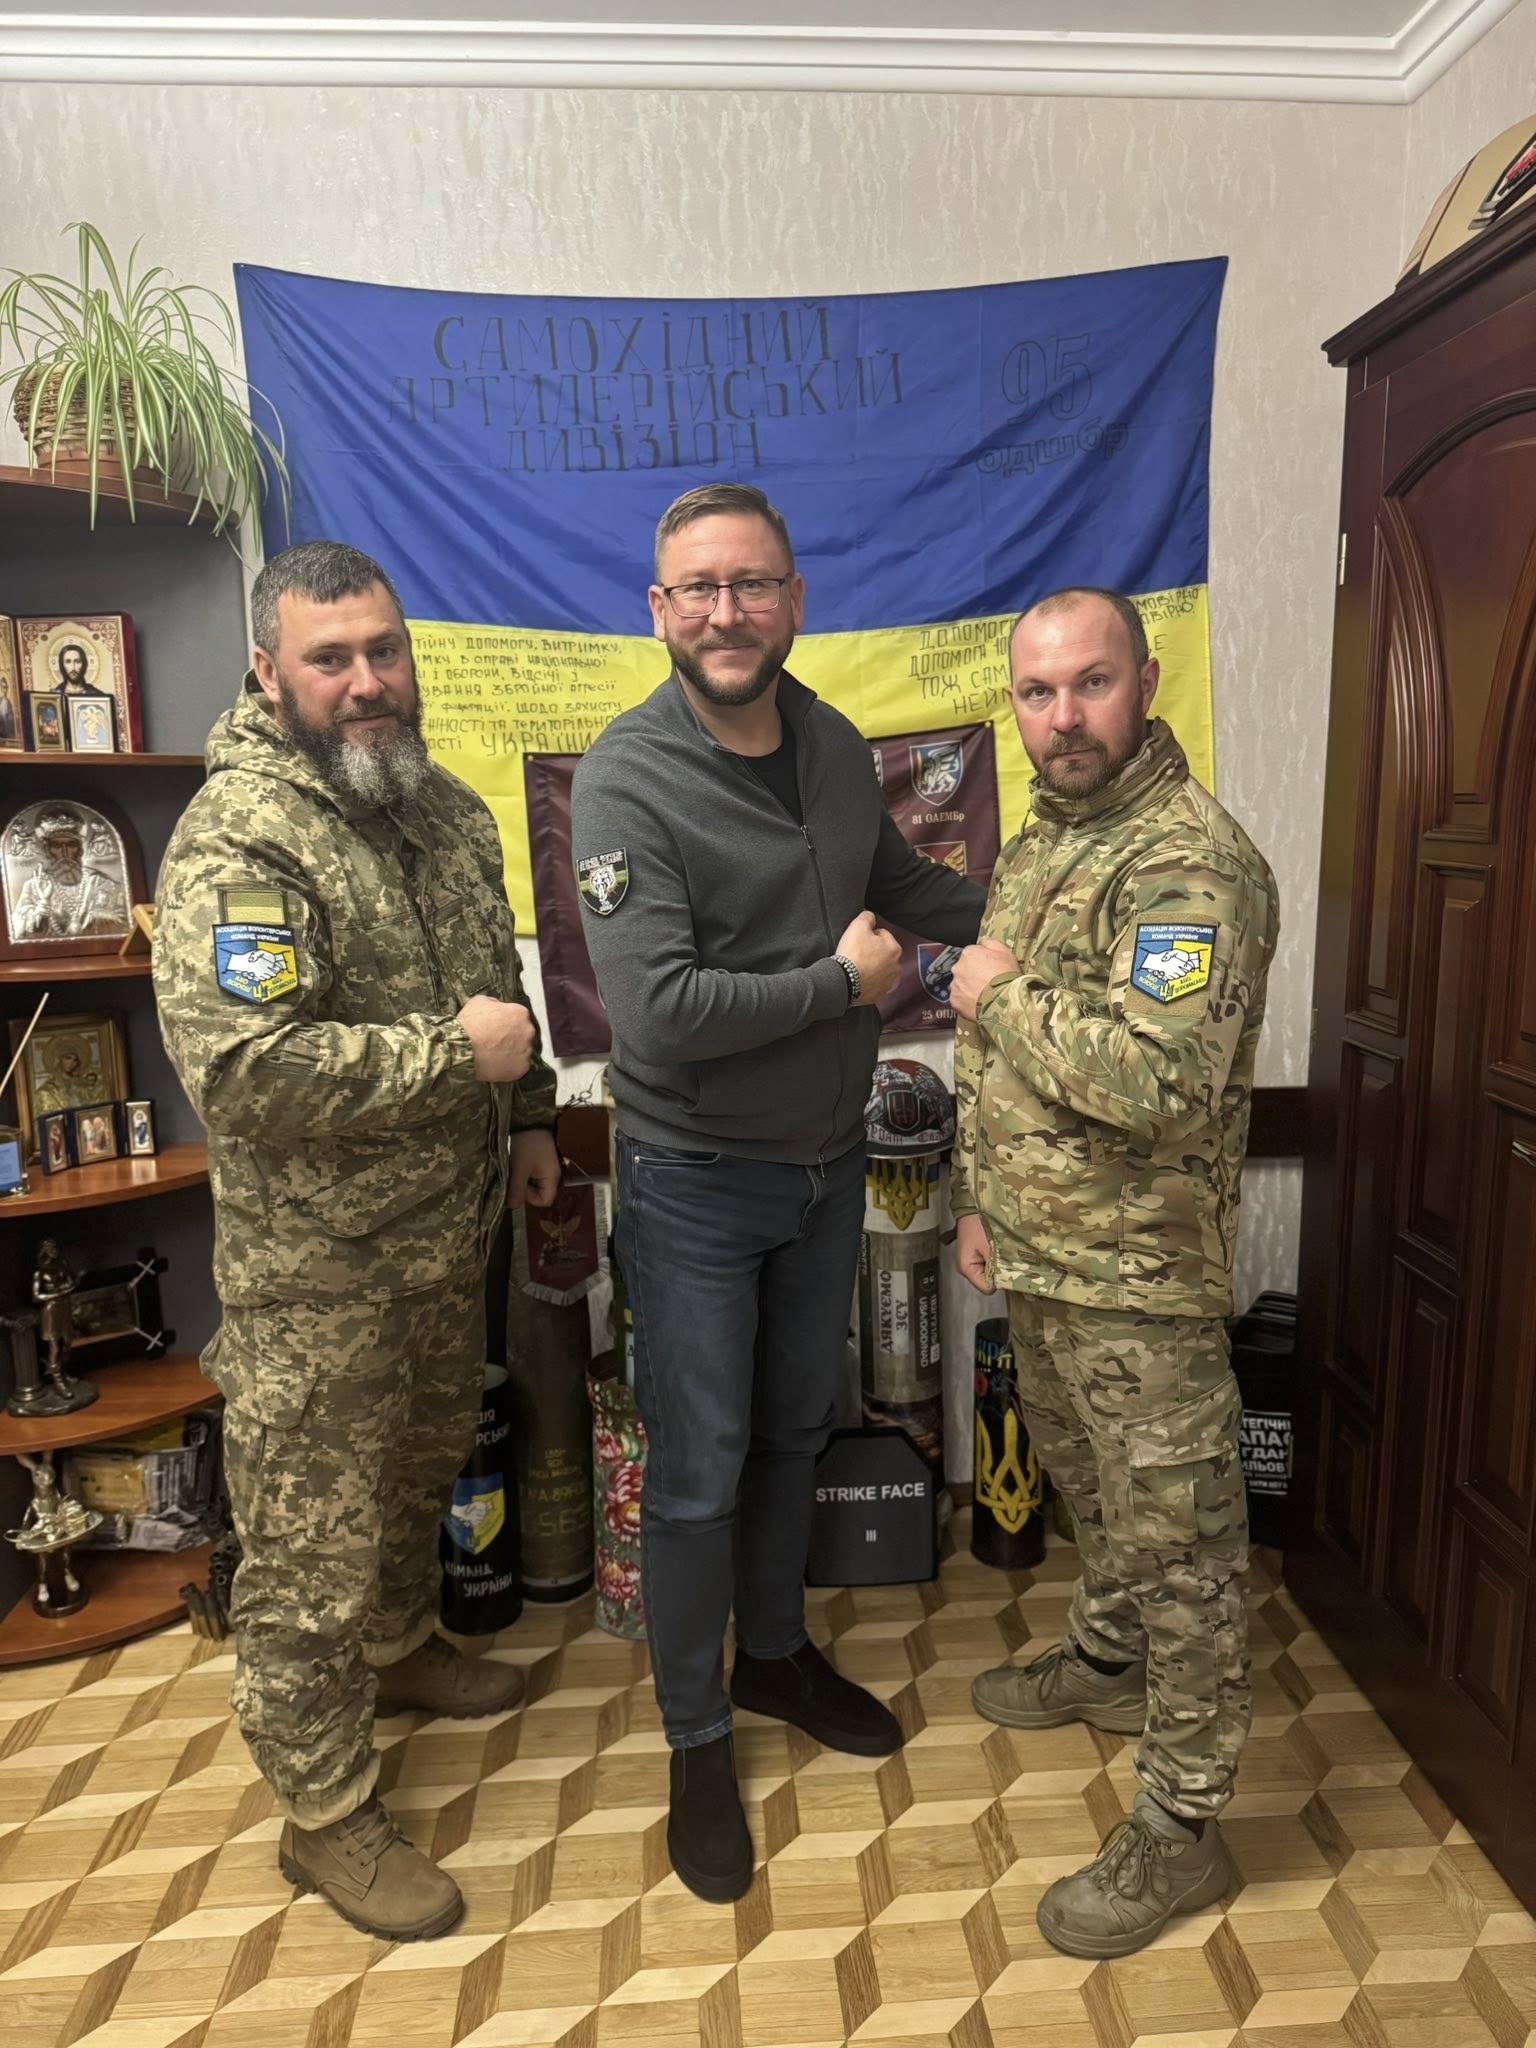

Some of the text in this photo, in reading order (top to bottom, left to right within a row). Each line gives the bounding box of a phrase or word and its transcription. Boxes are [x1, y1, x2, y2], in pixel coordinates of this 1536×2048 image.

[432, 303, 832, 374] САМОХІДНИЙ
[386, 347, 904, 427] АРТИЛЕРІЙСЬКИЙ
[1002, 333, 1093, 428] 95
[506, 420, 764, 473] ДИВІЗІОН
[1135, 588, 1199, 612] МОВІРНО
[415, 634, 456, 649] ТІЙНУ
[908, 643, 986, 678] ДОПОМОГА
[1140, 601, 1195, 625] ОВІРНО.
[422, 683, 482, 697] УВАННЯ
[917, 673, 962, 700] ТОЖ
[488, 719, 506, 731] ТА
[427, 731, 593, 757] ОСТІ УКРАЇНИ
[911, 814, 922, 825] 81
[921, 1010, 933, 1020] 25
[880, 1270, 892, 1353] ДЯКУЄМО
[896, 1301, 908, 1331] ЗСУ
[1239, 1430, 1294, 1447] АПАС
[815, 1482, 926, 1502] STRIKE FACE
[865, 1529, 877, 1542] III
[463, 1571, 513, 1598] УКРАЇНИ
